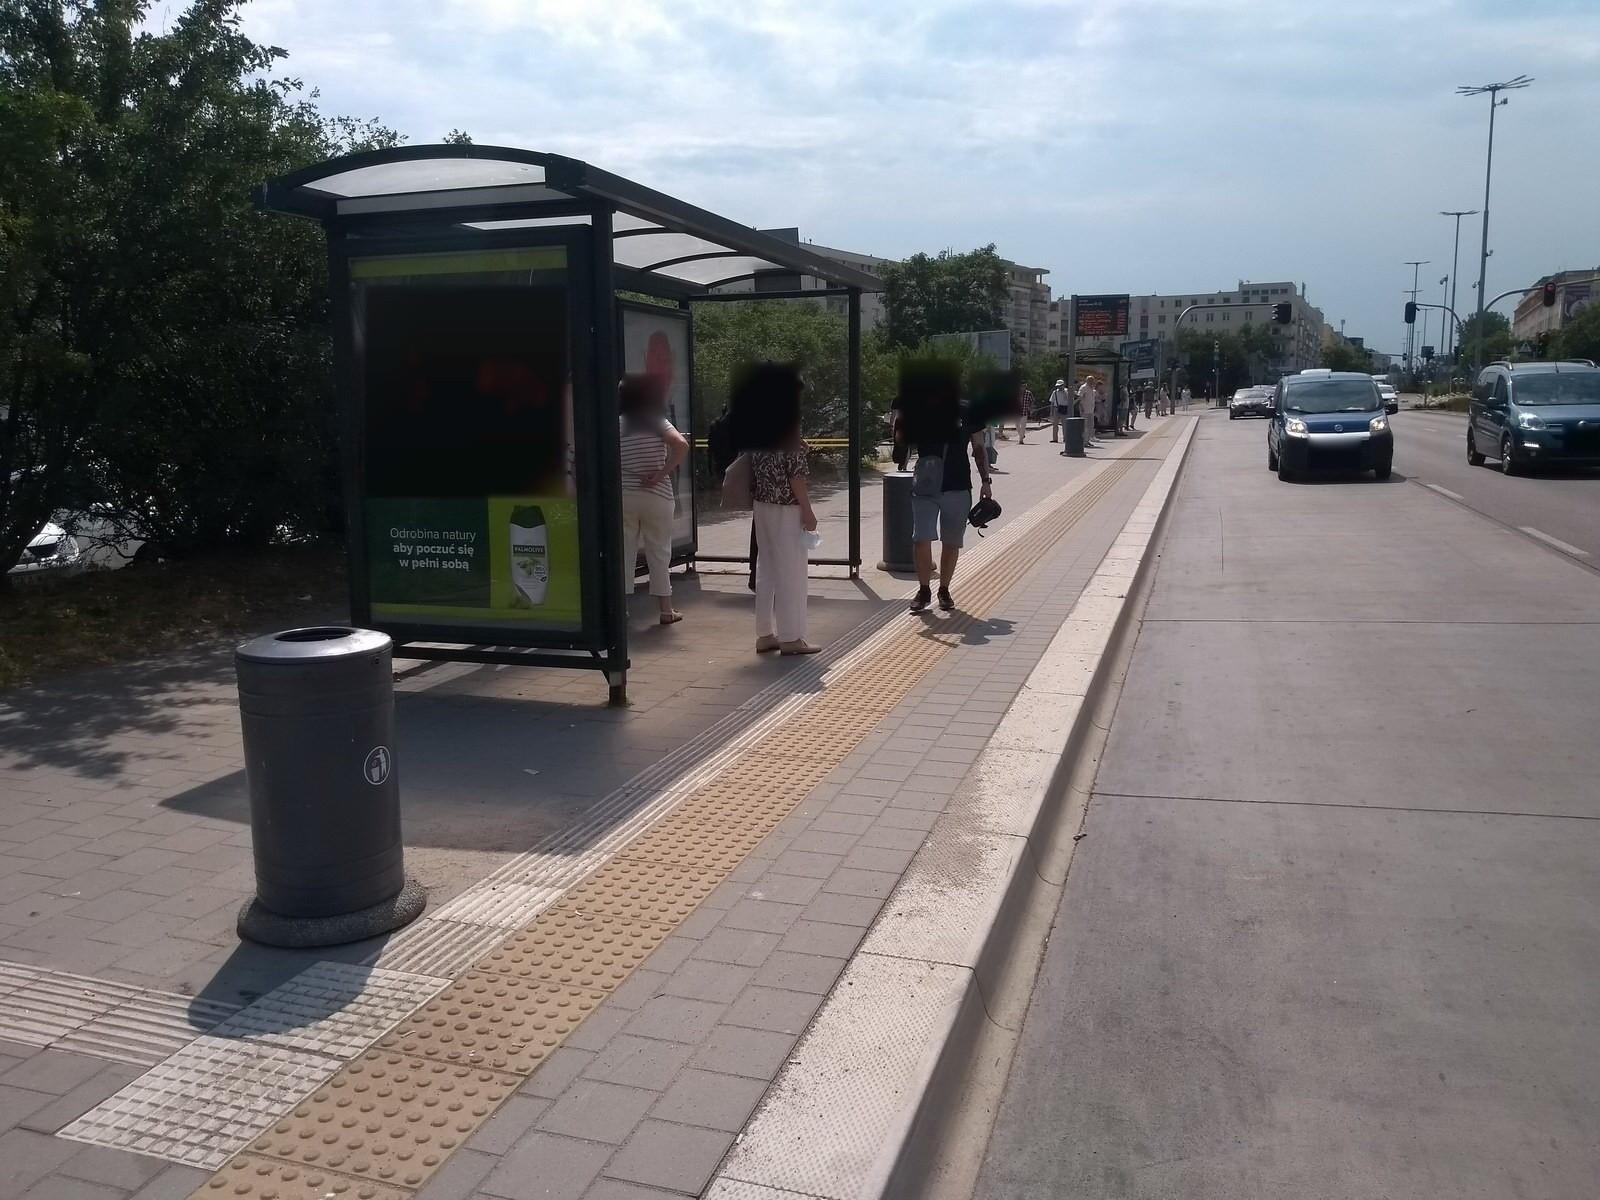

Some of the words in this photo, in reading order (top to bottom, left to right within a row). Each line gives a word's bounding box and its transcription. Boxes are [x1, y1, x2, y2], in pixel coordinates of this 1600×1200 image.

[390, 527, 440, 540] Odrobina
[442, 530, 477, 543] natury
[393, 542, 414, 555] aby
[416, 543, 455, 555] poczuć
[457, 544, 474, 557] się
[399, 559, 409, 567] w
[412, 557, 439, 570] pełni
[441, 558, 470, 572] sobą
